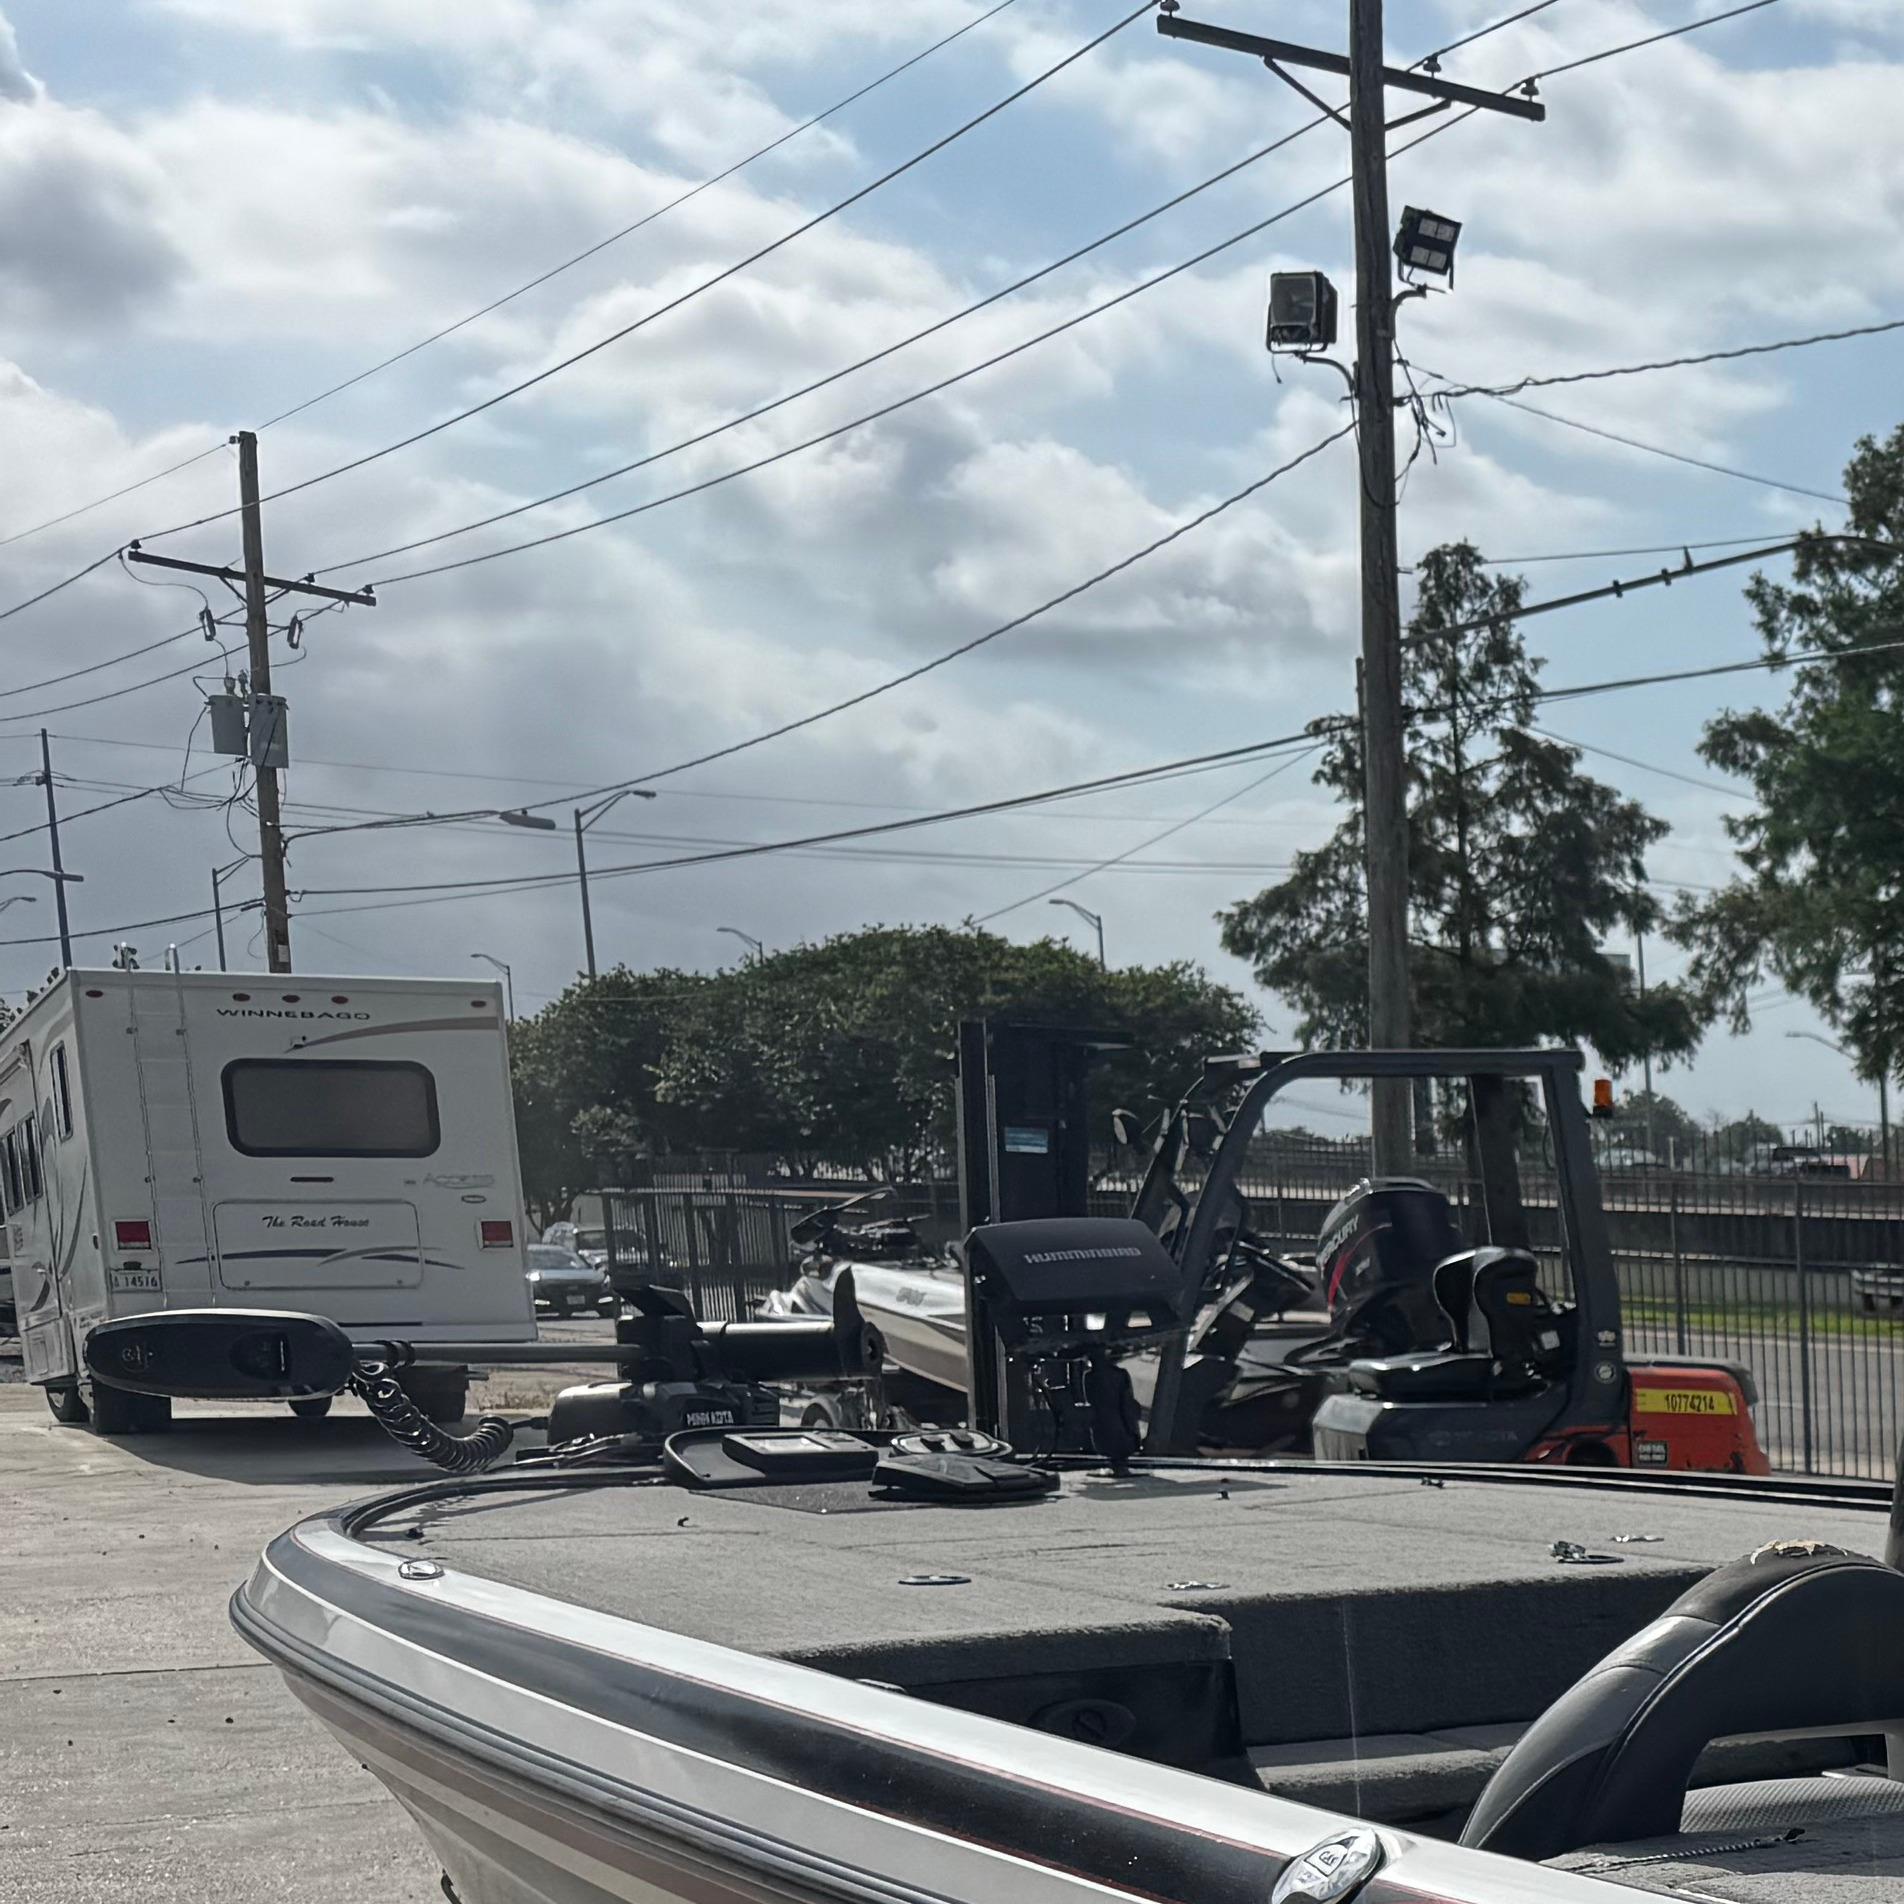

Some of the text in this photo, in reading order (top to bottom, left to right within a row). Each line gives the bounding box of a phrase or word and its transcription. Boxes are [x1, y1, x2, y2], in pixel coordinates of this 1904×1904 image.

[216, 1008, 372, 1021] WINNEBAGO
[262, 1215, 285, 1228] The
[291, 1215, 326, 1228] Road
[1024, 1247, 1142, 1264] HUMMINBIRD
